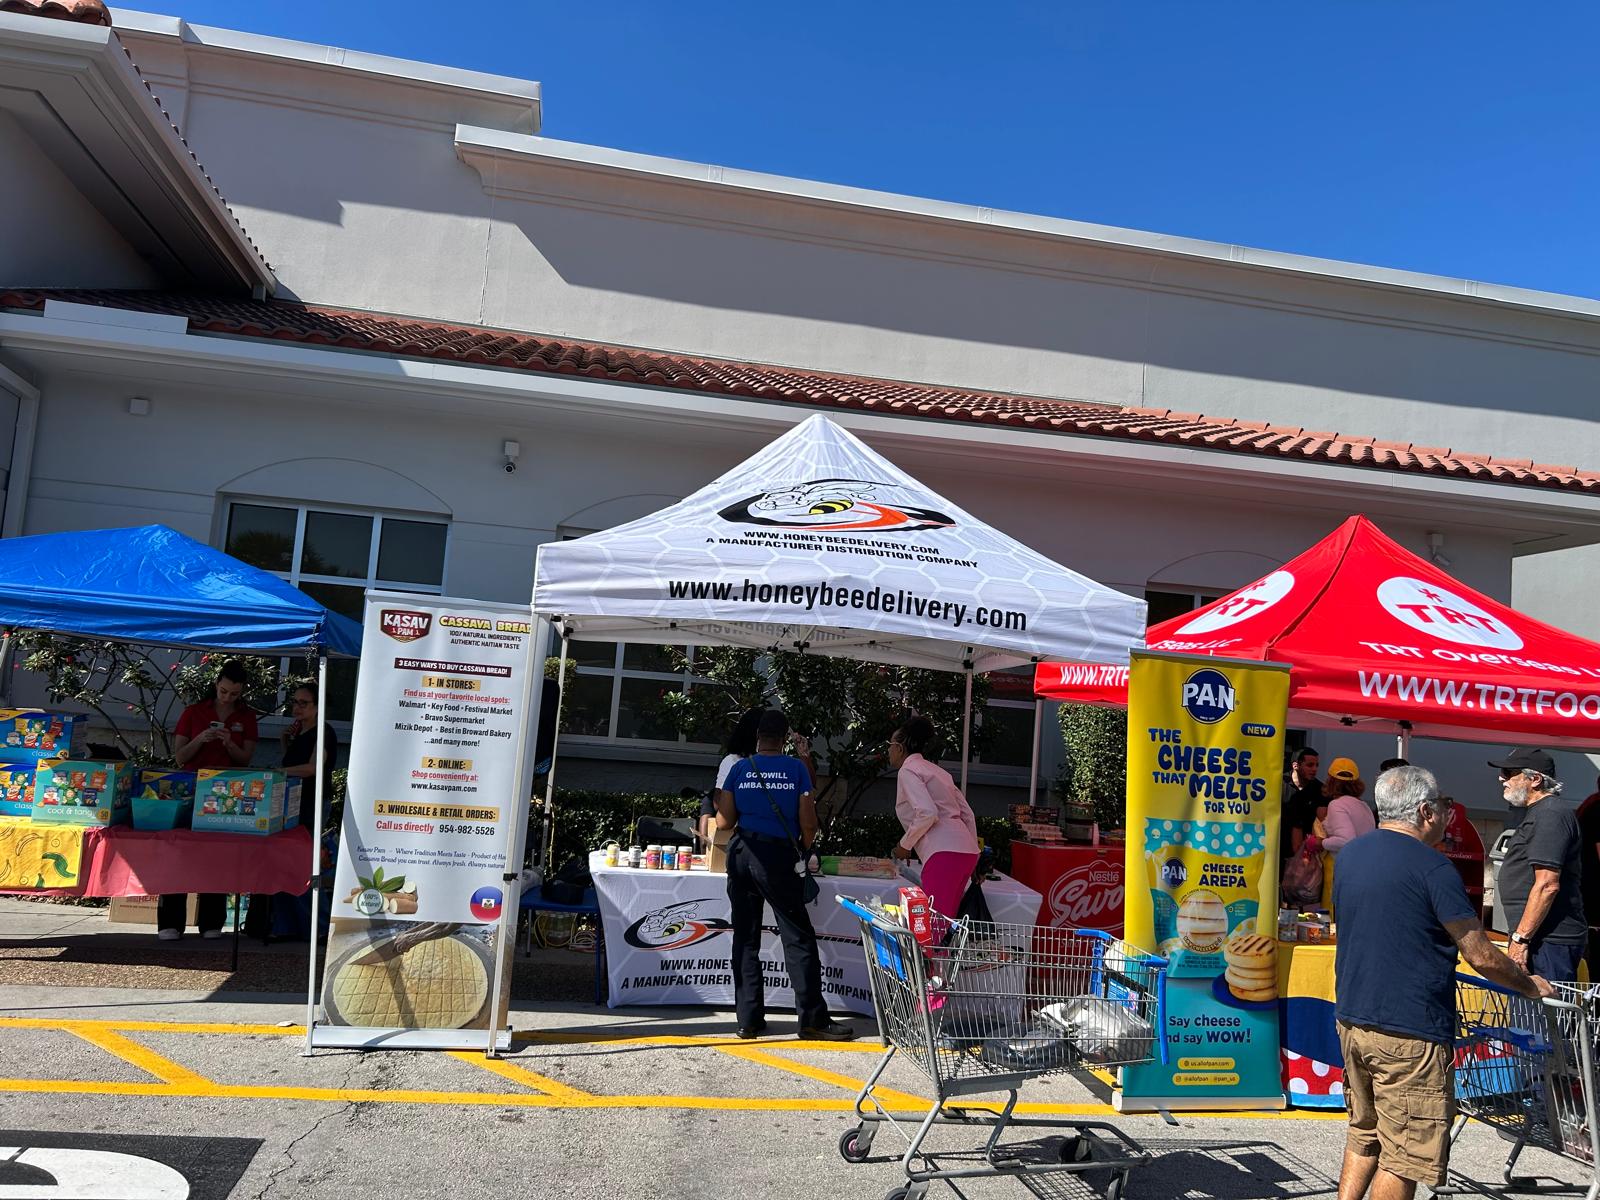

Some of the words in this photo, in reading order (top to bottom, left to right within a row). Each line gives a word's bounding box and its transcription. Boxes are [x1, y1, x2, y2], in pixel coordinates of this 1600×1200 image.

[744, 531, 940, 554] WWW.HONEYBEEDELIVERY.COM
[719, 538, 822, 551] MANUFACTURER
[826, 545, 913, 560] DISTRIBUTION
[916, 554, 978, 568] COMPANY
[669, 578, 1027, 631] www.honeybeedelivery.com
[384, 613, 428, 629] KASAV
[439, 616, 492, 630] CASSAVA
[1396, 603, 1500, 634] TRT
[397, 628, 414, 636] PAM
[463, 632, 486, 640] NATURAL
[488, 634, 522, 642] INGREDIENTS
[450, 638, 480, 646] AUTHENTIC
[503, 642, 520, 650] TASTE
[1358, 641, 1424, 659] TRT
[1432, 648, 1582, 676] Overseas
[459, 664, 485, 673] CASSAVA
[437, 678, 444, 687] IN
[446, 679, 475, 689] STORES:
[404, 689, 418, 697] Find
[434, 692, 449, 701] your
[449, 692, 474, 701] favorite
[474, 694, 490, 702] local
[491, 696, 510, 704] spots:
[1358, 670, 1600, 720] WWW.TRTFOO
[399, 700, 426, 709] Walmart
[431, 703, 443, 711] Key
[444, 704, 460, 712] Food
[464, 705, 489, 713] Festival
[490, 707, 513, 715] Market
[444, 715, 485, 725] Supermarket
[414, 724, 432, 733] Depot
[440, 726, 455, 734] Best
[462, 728, 488, 736] Broward
[489, 730, 512, 739] Bakery
[1148, 728, 1182, 743] THE
[1247, 726, 1269, 736] NEW
[438, 760, 466, 770] ONLINE:
[1158, 744, 1252, 776] CHEESE
[411, 770, 428, 779] Shop
[429, 771, 469, 781] conveniently
[411, 782, 477, 792] www.kasavpam.com
[1152, 771, 1186, 785] THAT
[1189, 773, 1266, 801] MELTS
[378, 804, 386, 813] 3.
[388, 805, 430, 816] WHOLESALE
[432, 808, 437, 816] &
[440, 808, 463, 818] RETAIL
[466, 809, 496, 820] ORDERS:
[1204, 800, 1225, 814] FOR
[1228, 802, 1250, 815] YOU
[376, 820, 392, 829] Call
[404, 822, 434, 834] directly
[439, 824, 495, 836] 954-982-5526
[468, 861, 486, 869] Always
[1202, 863, 1244, 874] CHEESE
[1199, 874, 1247, 888] AREPA
[621, 977, 629, 989] A
[633, 975, 731, 988] MANUFACTURER
[821, 982, 874, 1002] COMPANY
[1169, 1015, 1190, 1028] Say
[1195, 1015, 1241, 1027] cheese
[1166, 1032, 1180, 1043] nd
[1184, 1033, 1203, 1044] say
[1206, 1028, 1251, 1043] WOW!
